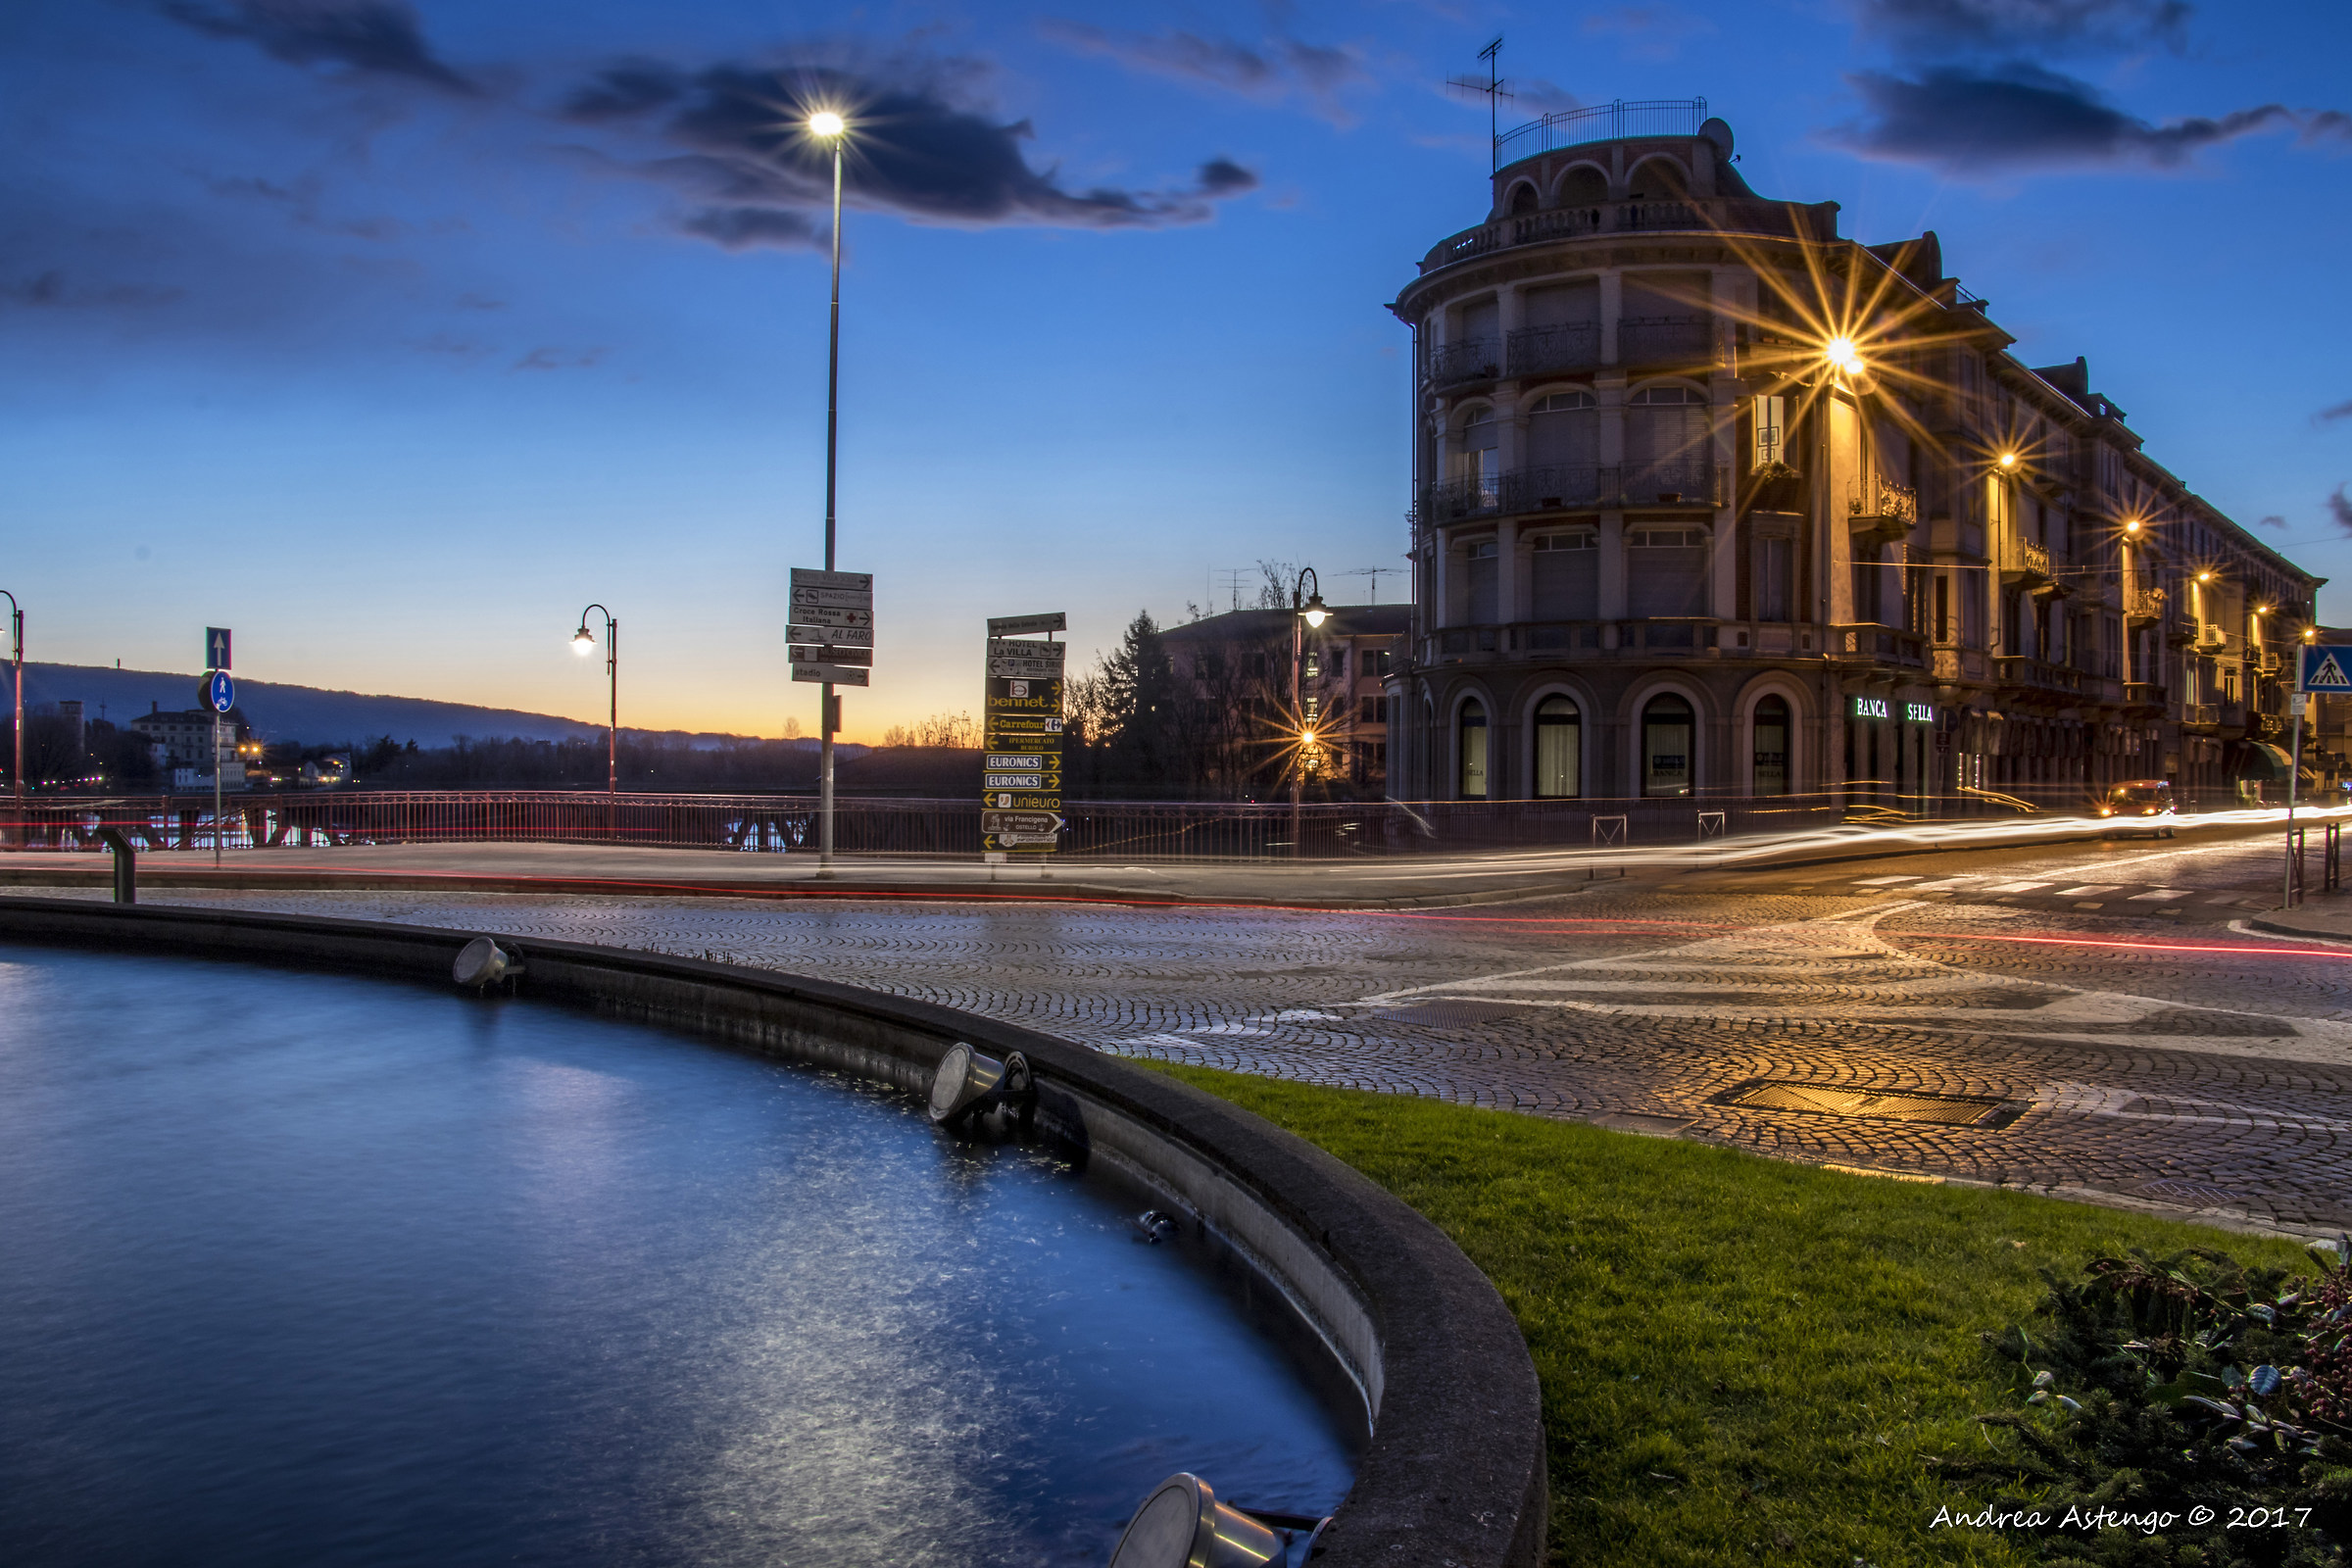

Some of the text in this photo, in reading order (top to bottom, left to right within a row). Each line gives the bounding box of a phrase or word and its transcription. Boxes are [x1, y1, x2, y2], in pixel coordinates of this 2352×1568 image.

[819, 592, 845, 601] SPAZIO
[794, 607, 841, 617] Croce Rossa
[803, 615, 831, 624] Italiana
[831, 629, 871, 641] AL FARO
[1008, 640, 1038, 649] HOTEL
[994, 647, 1033, 657] La VILLA
[795, 667, 821, 677] stadio
[988, 694, 1049, 709] bennet
[1857, 698, 1934, 722] BANCA SELLA
[1000, 719, 1045, 729] Carrefour
[990, 757, 1039, 767] EURONICS
[989, 775, 1039, 786] EURONICS
[1013, 795, 1060, 808] unieuro
[1014, 815, 1049, 824] Francigena
